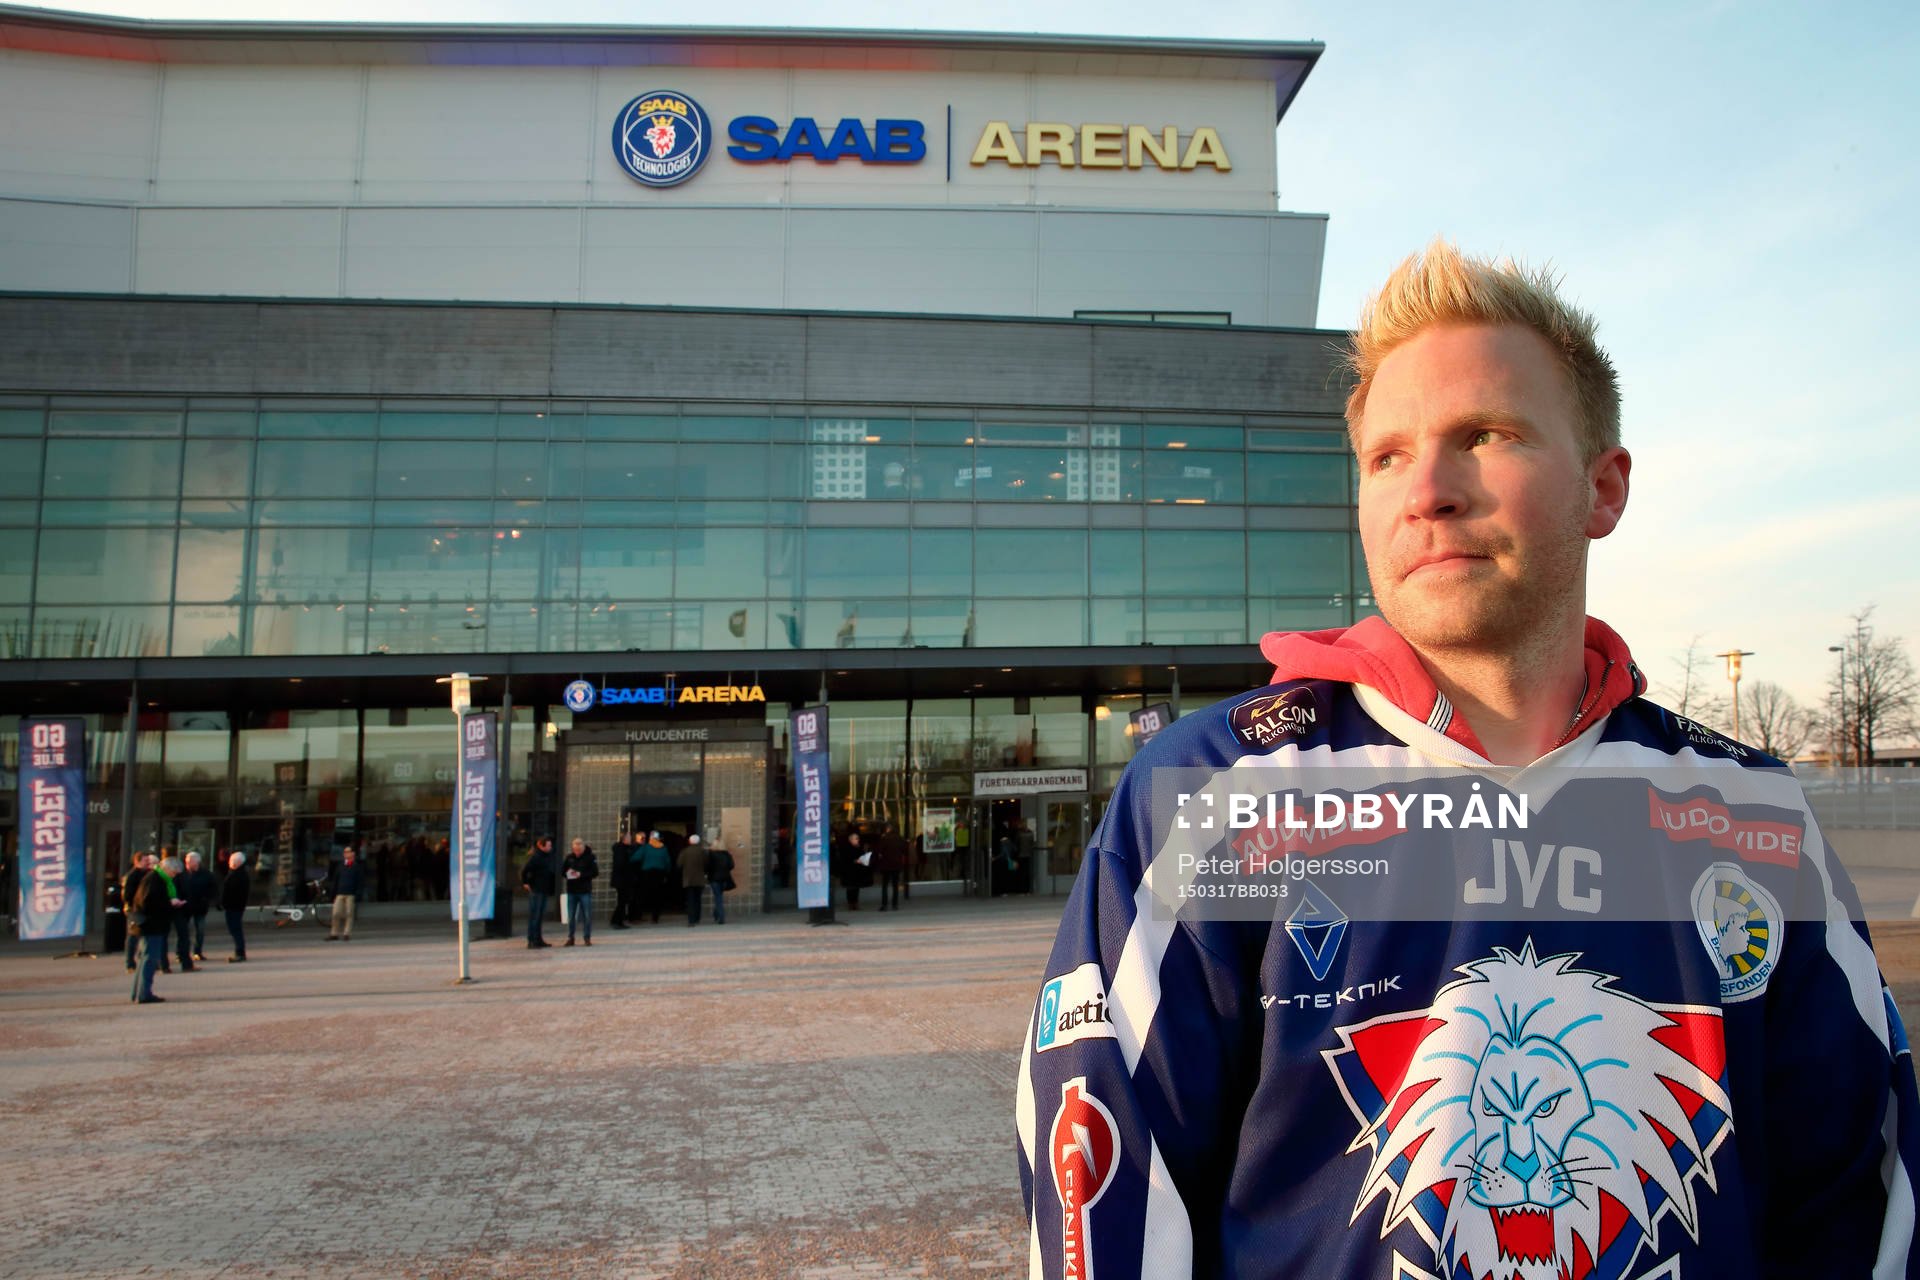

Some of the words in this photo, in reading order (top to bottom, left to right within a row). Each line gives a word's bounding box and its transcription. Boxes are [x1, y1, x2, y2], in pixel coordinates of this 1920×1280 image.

[638, 99, 687, 116] SAAB
[727, 115, 927, 163] SAAB
[970, 120, 1231, 171] ARENA
[632, 153, 691, 176] TECHNOLOGIES
[602, 687, 665, 704] SAAB
[678, 685, 765, 702] ARENA
[625, 728, 709, 741] HUVUDENTRÉ
[1241, 706, 1317, 741] FALCON
[1675, 716, 1748, 757] FALON
[979, 775, 1083, 788] FÖRETAGSARRANGEMANG
[1464, 838, 1602, 914] JVC
